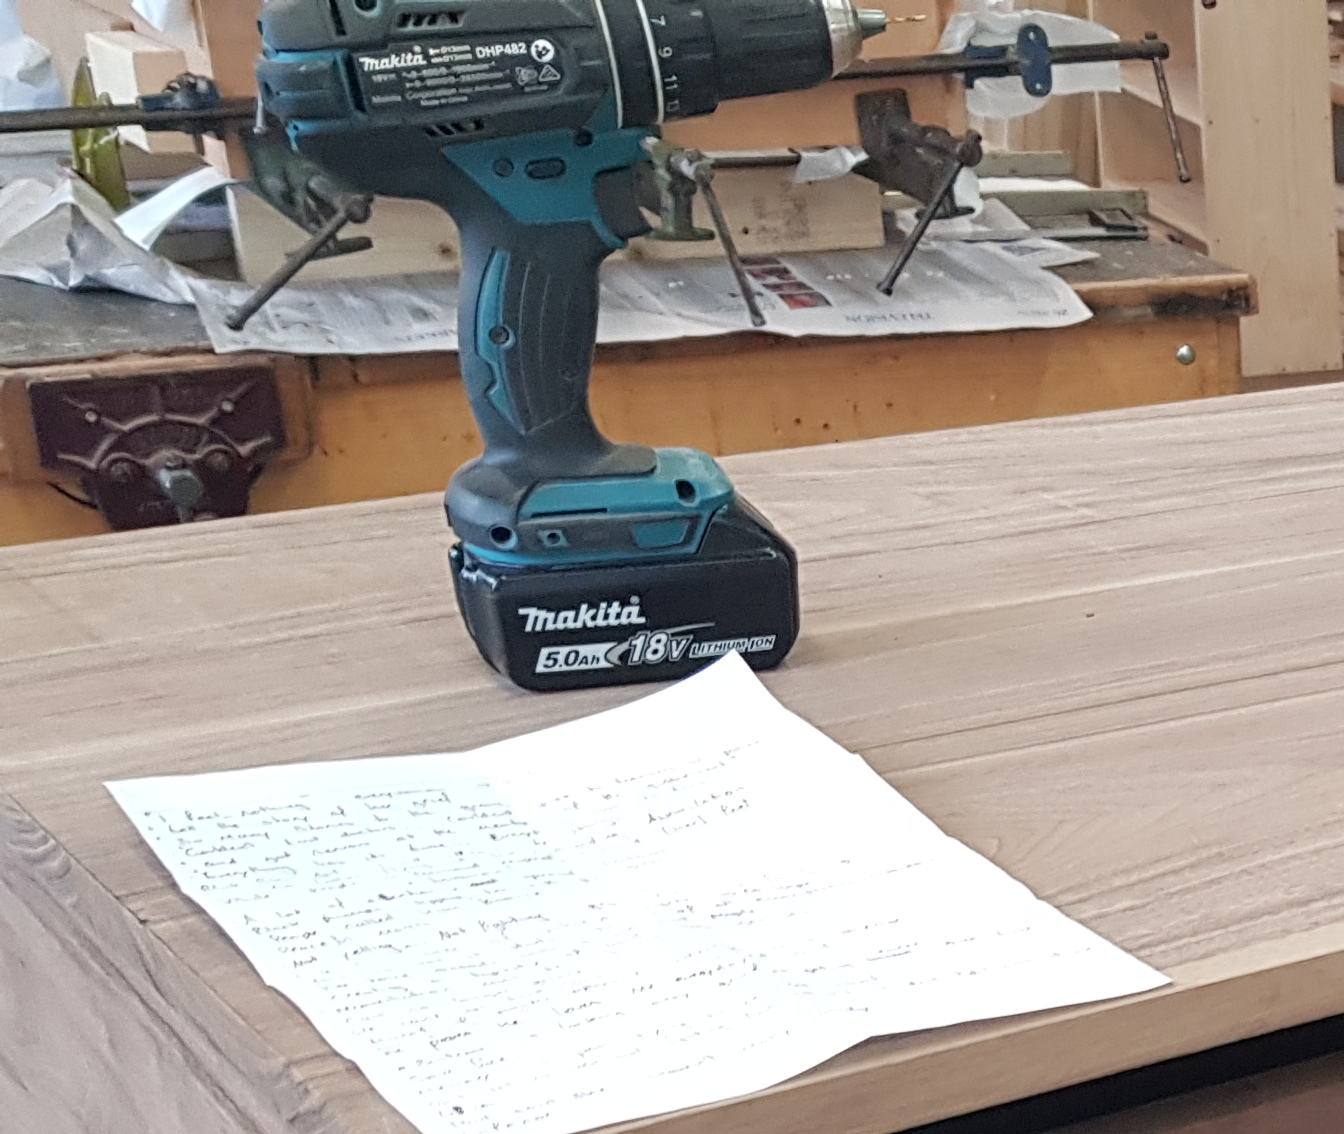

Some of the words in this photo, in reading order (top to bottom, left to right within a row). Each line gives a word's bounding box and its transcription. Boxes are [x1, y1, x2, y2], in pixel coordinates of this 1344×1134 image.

[475, 42, 528, 60] DHP482
[541, 650, 600, 670] 5.0Ah
[628, 630, 693, 666] 18V
[692, 640, 748, 657] LITHIUM
